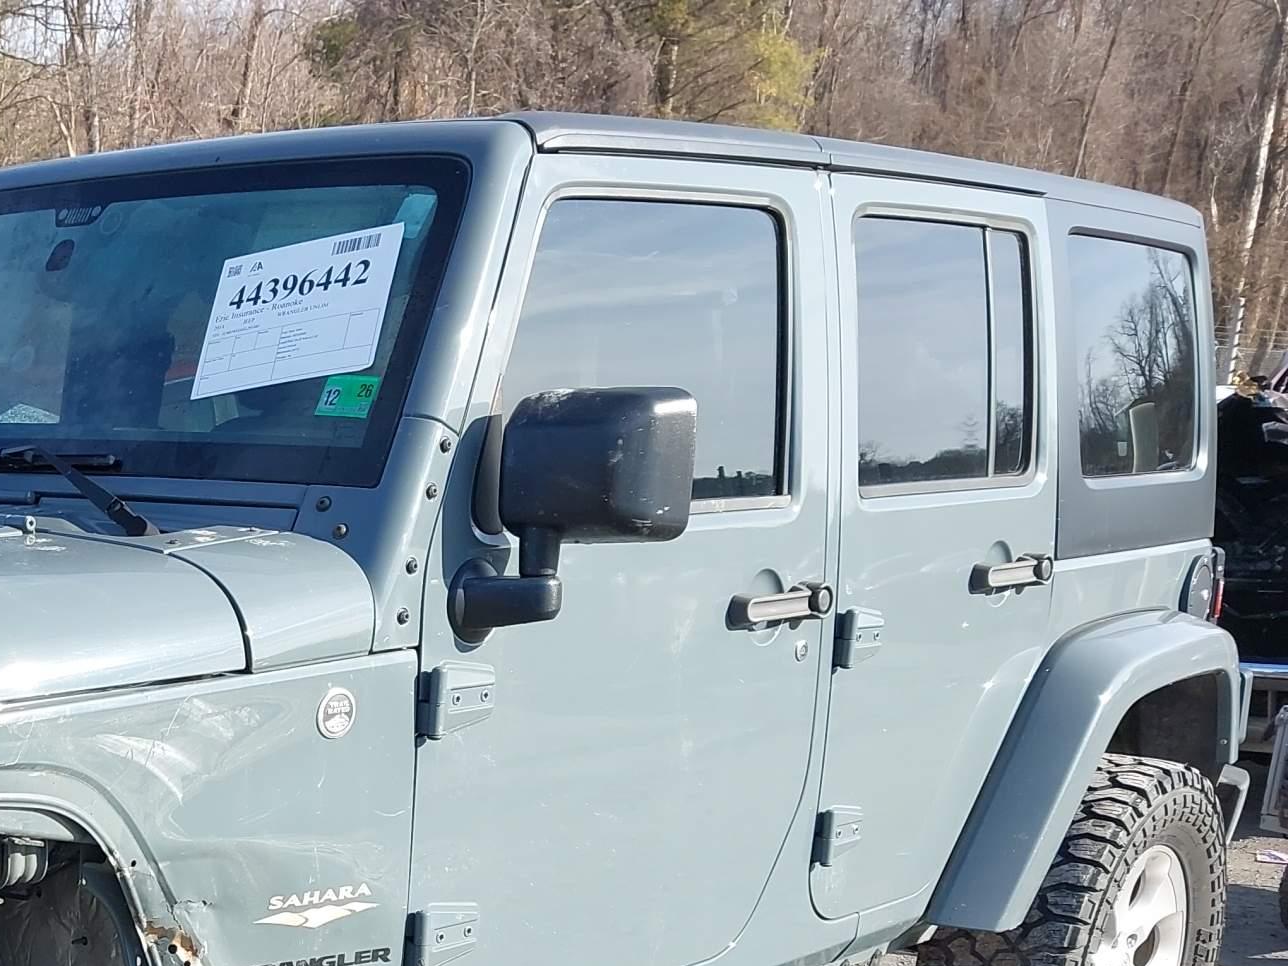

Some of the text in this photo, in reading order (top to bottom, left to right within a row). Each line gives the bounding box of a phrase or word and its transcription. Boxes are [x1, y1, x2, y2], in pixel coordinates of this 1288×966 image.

[228, 259, 372, 310] 44396442
[231, 306, 265, 320] Insurance
[272, 298, 304, 311] Roanoke
[324, 389, 341, 406] 12
[357, 383, 375, 398] 26
[268, 882, 373, 911] SAHARA
